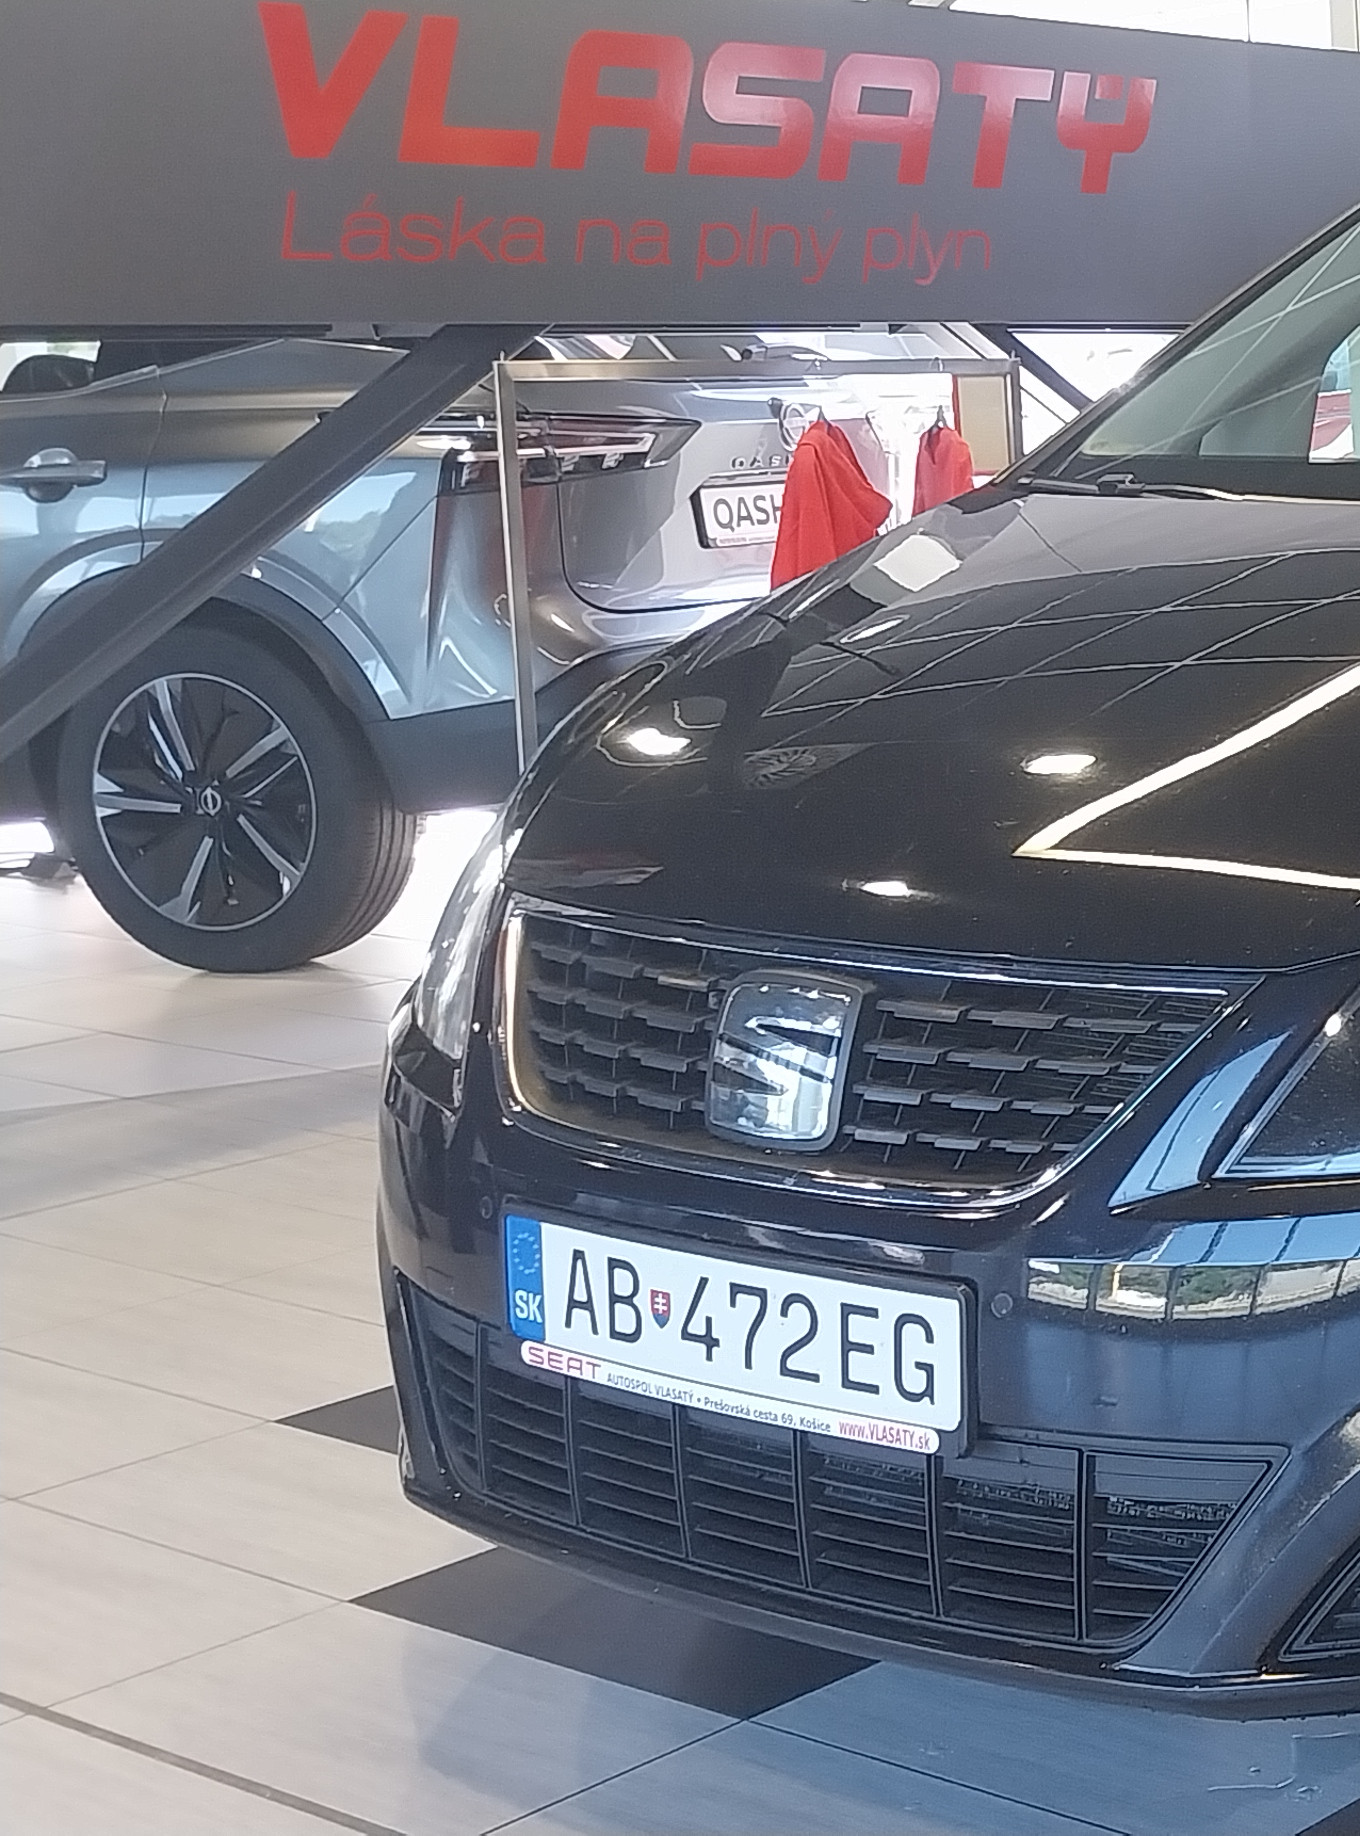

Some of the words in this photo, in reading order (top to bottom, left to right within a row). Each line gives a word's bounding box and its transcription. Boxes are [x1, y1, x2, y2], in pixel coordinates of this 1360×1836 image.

[280, 190, 547, 264] Láska
[574, 217, 673, 266] na
[694, 206, 843, 285] plný
[862, 212, 992, 287] plyn
[514, 1290, 543, 1323] SK
[528, 1346, 601, 1379] SEAT
[607, 1373, 653, 1394] AUTOSPOL
[753, 1409, 778, 1422] cesta
